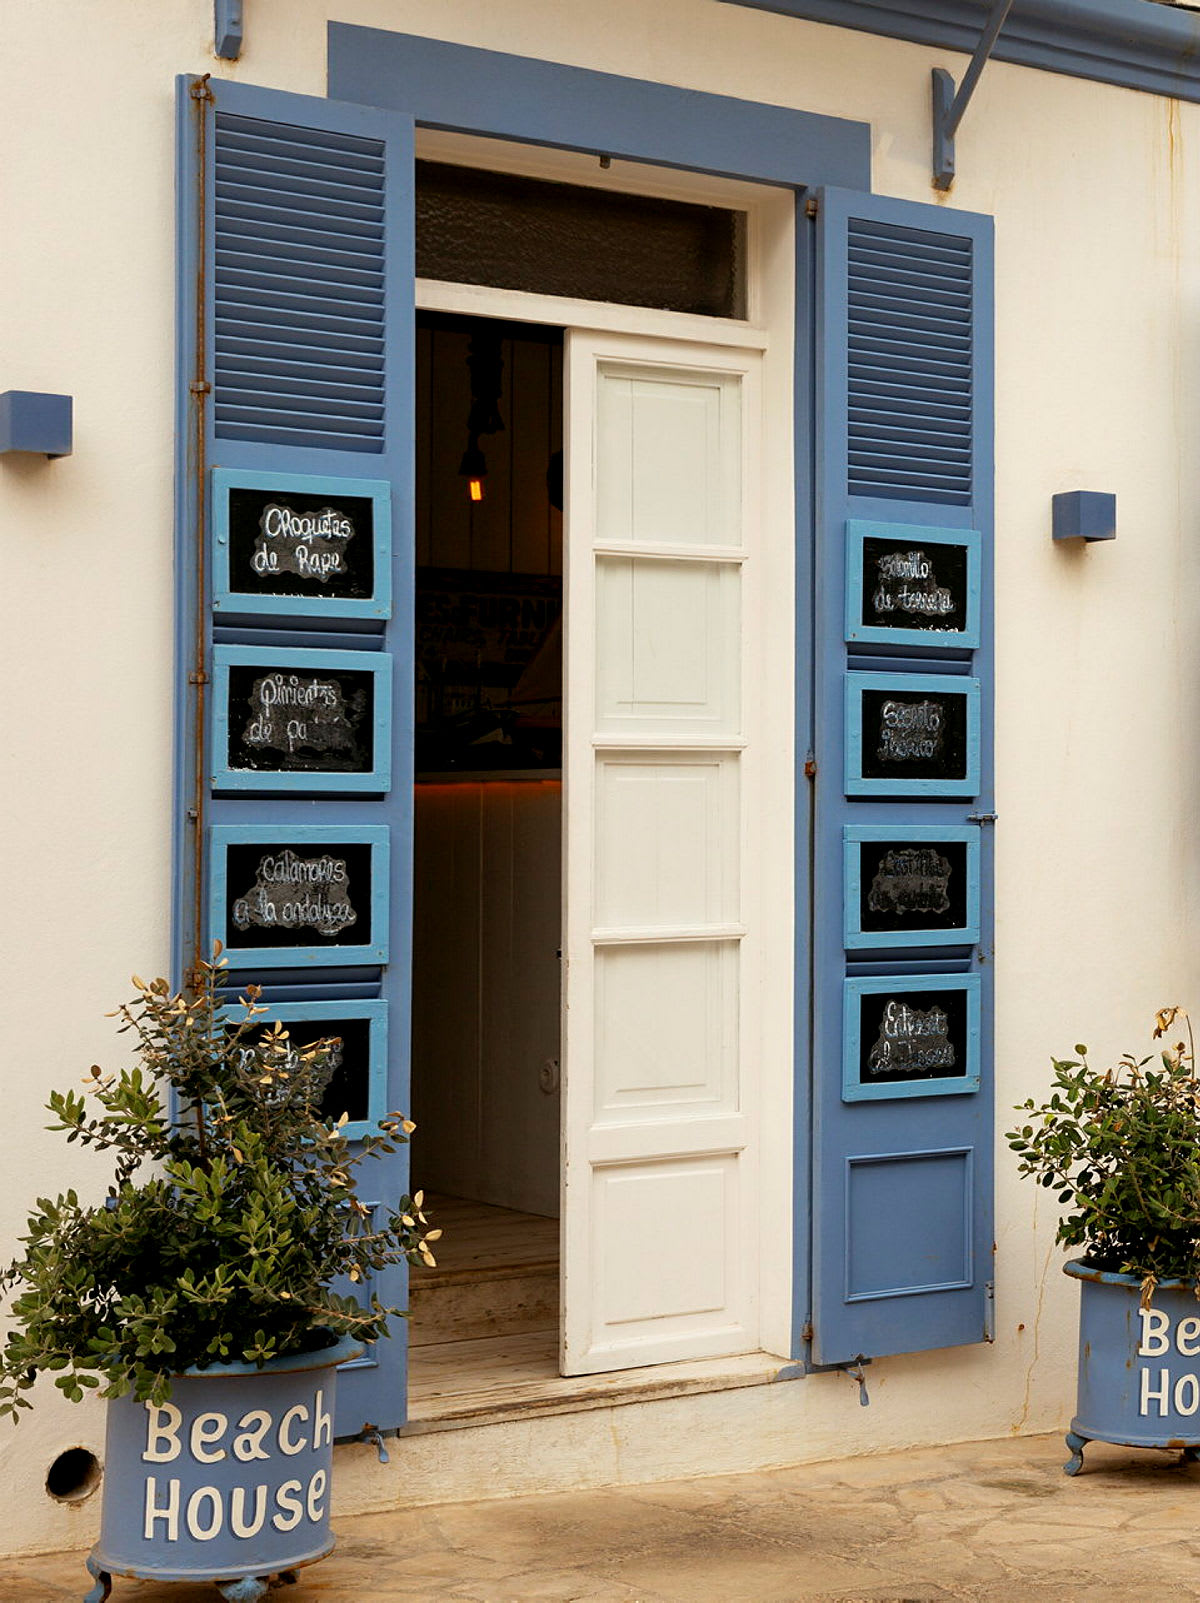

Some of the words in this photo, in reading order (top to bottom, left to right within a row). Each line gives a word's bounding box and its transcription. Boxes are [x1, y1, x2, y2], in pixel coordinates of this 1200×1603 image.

[254, 542, 280, 572] de
[249, 714, 273, 743] de
[142, 1390, 331, 1463] Beach
